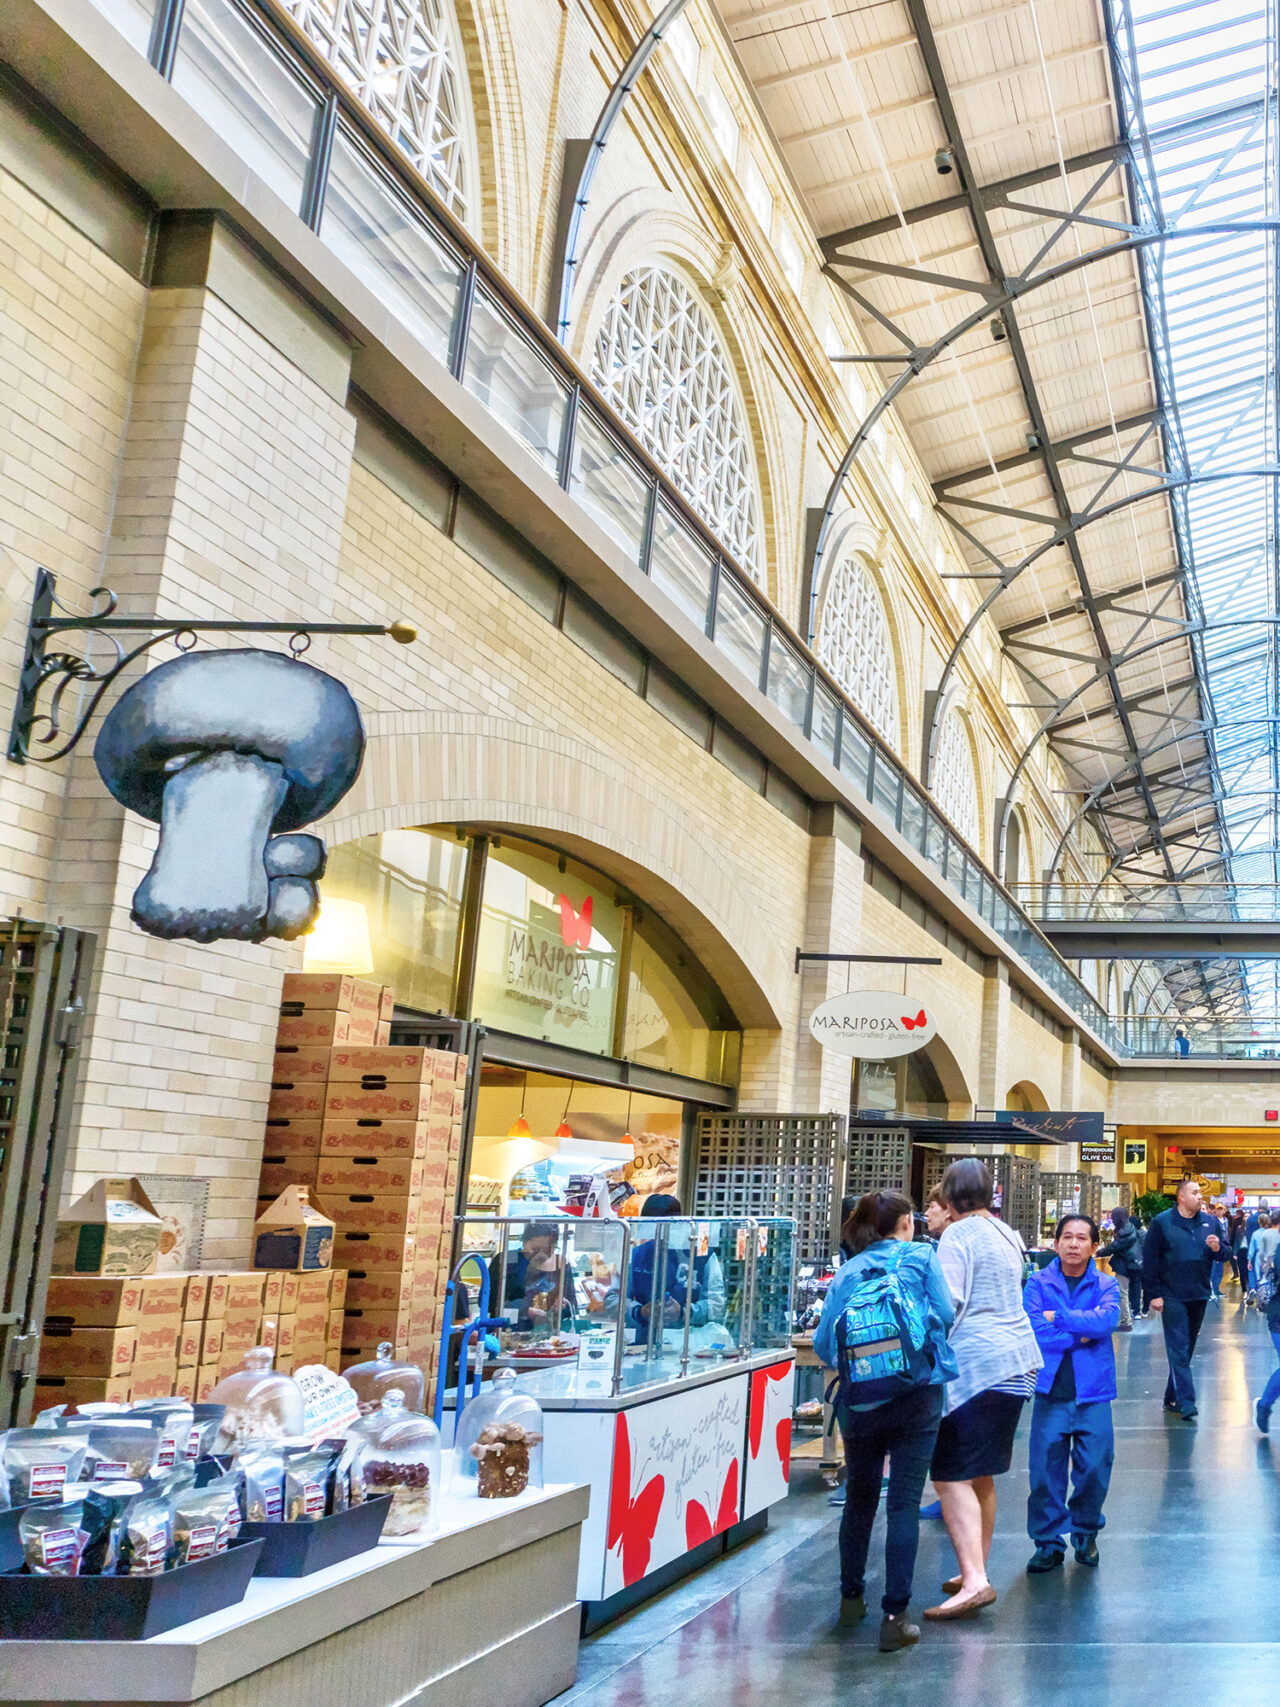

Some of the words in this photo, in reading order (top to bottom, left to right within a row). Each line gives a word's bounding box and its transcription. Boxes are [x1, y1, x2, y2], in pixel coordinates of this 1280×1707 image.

[509, 930, 591, 985] MARIPOSA
[507, 960, 563, 1000] BAKING
[571, 983, 590, 1009] CO
[812, 1016, 899, 1031] MARIPOSA
[300, 1372, 325, 1393] GROW
